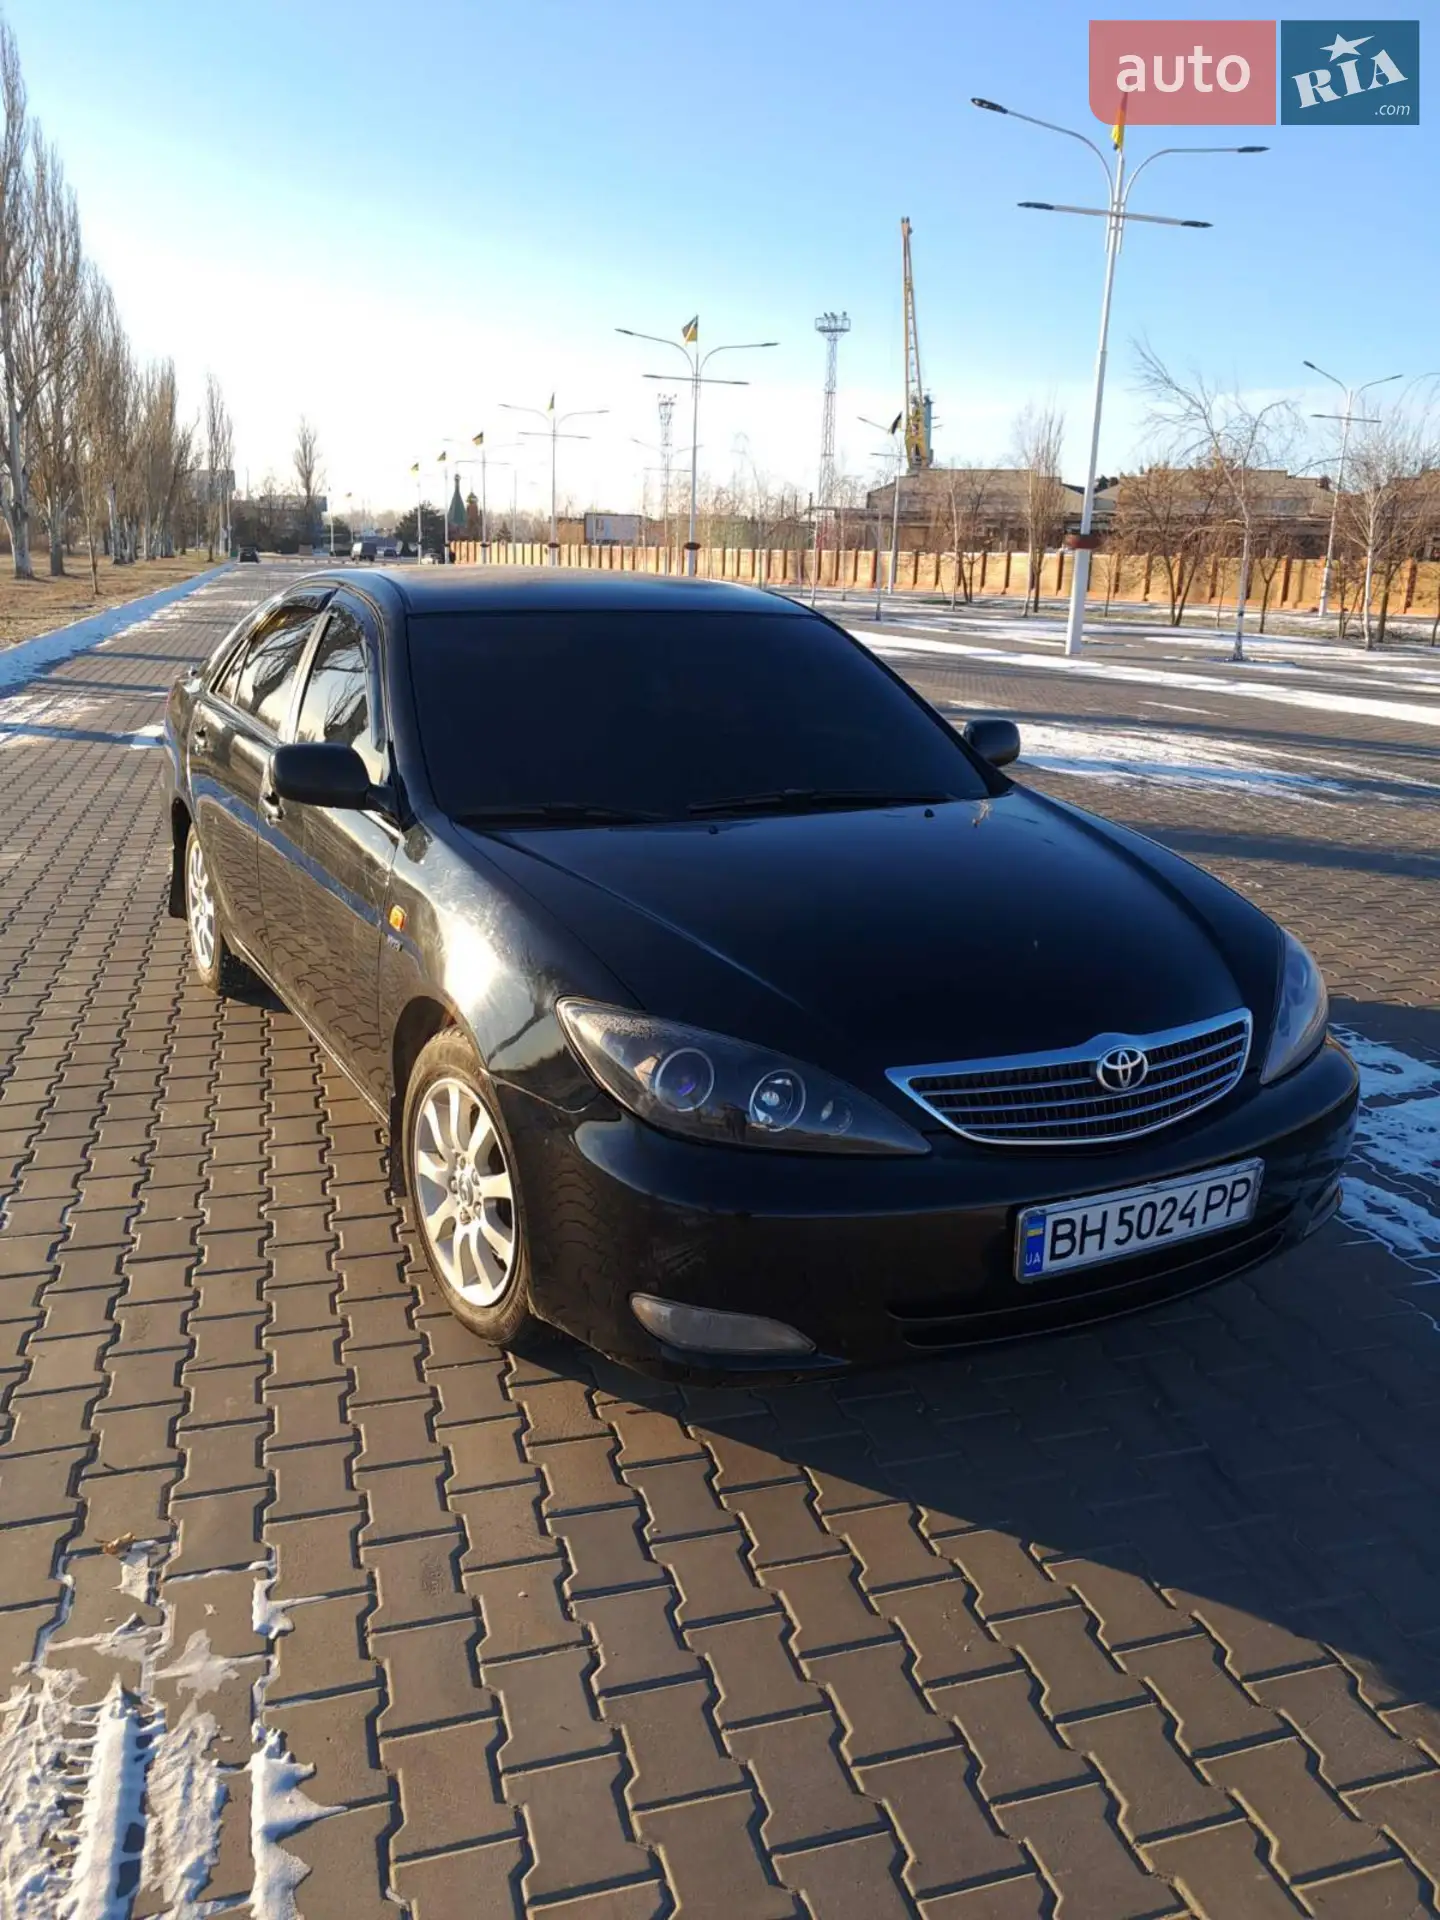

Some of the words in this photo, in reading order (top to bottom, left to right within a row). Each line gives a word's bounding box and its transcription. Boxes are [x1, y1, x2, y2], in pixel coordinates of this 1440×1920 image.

[1049, 1210, 1108, 1262] BH
[1114, 1189, 1199, 1247] 5024
[1201, 1176, 1251, 1225] PP
[1025, 1252, 1042, 1267] UA
